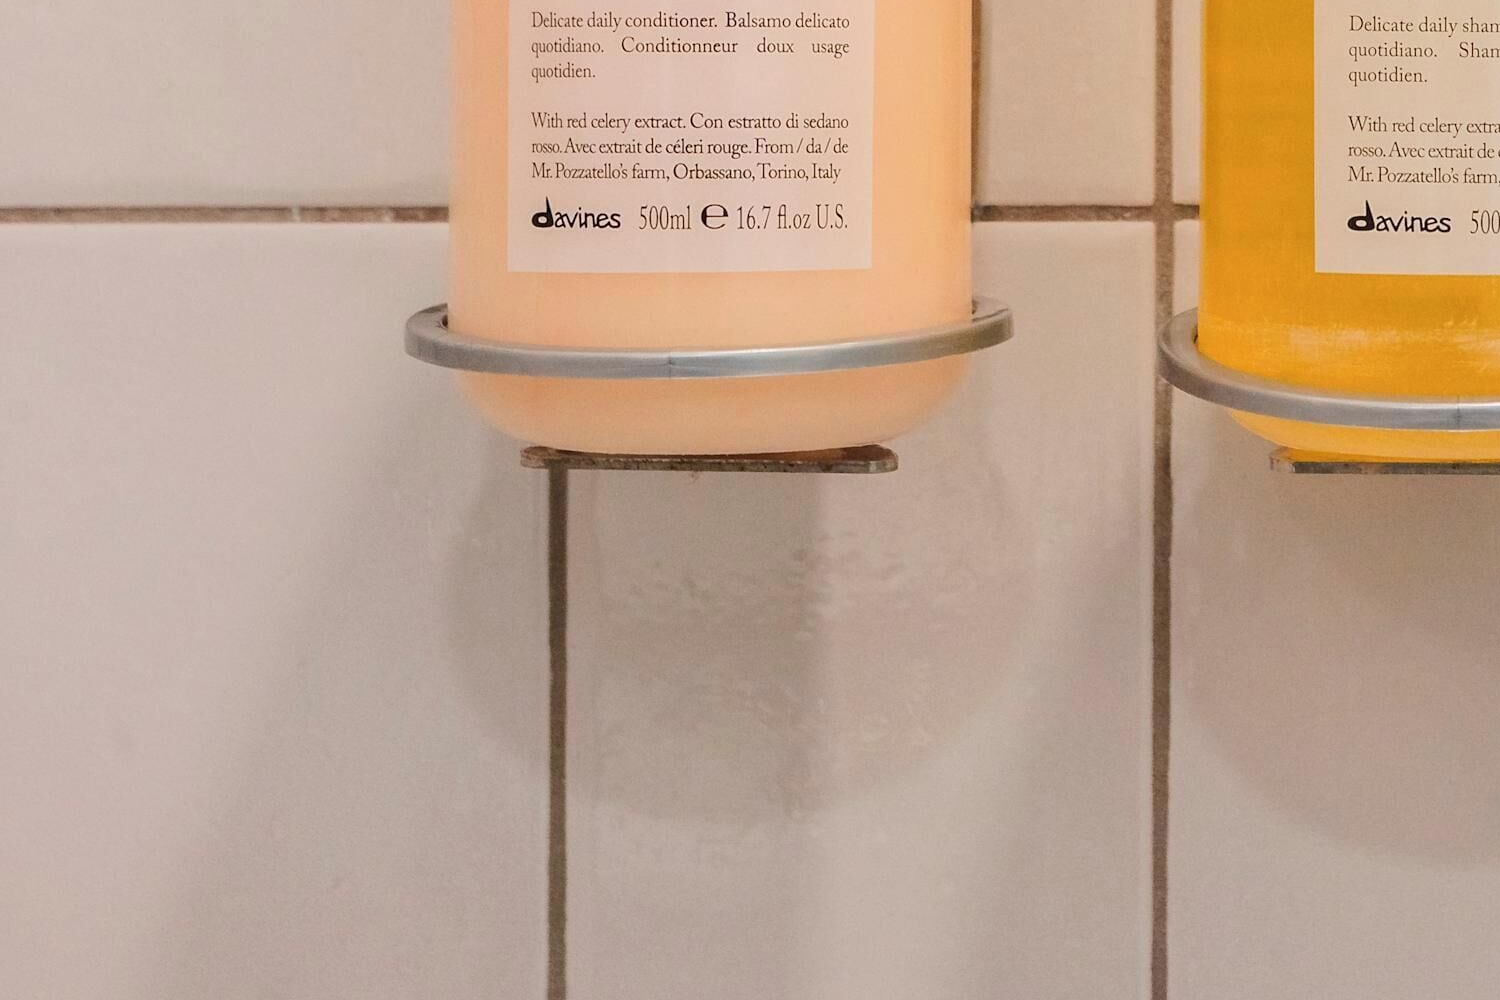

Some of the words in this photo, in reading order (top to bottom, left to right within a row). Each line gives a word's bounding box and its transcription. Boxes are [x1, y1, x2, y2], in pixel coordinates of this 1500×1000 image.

[532, 12, 583, 27] Delicate
[587, 11, 622, 32] daily
[625, 11, 717, 27] conditioner.
[725, 12, 791, 28] Balsamo
[795, 12, 849, 28] delicato
[1350, 15, 1413, 32] Delicate
[1419, 16, 1458, 38] daily
[531, 37, 604, 58] quotidiano.
[622, 36, 738, 53] Conditionneur
[757, 37, 794, 53] doux
[812, 43, 849, 59] usage
[1349, 41, 1437, 62] quotidiano.
[532, 62, 595, 83] quotidien.
[1349, 66, 1427, 87] quotidien.
[531, 112, 563, 128] With
[567, 112, 587, 128] red
[591, 112, 631, 134] celery
[635, 117, 686, 128] extract.
[690, 113, 723, 128] Con
[728, 117, 781, 128] estratto
[786, 113, 799, 128] di
[803, 113, 848, 128] sedano
[1348, 116, 1387, 132] With
[1392, 117, 1415, 132] red
[1420, 117, 1463, 138] celery
[532, 143, 562, 153] rosso.
[564, 137, 596, 153] Avec
[599, 139, 642, 153] extrait
[645, 138, 662, 153] de
[666, 138, 703, 153] céleri
[707, 144, 751, 159] rouge.
[1349, 147, 1386, 157] rosso.
[1389, 141, 1425, 158] Avec
[1428, 144, 1474, 158] extrait
[1477, 142, 1494, 158] de
[532, 162, 552, 178] Mr.
[632, 163, 670, 182] farm,
[673, 163, 755, 182] Orbassano,
[757, 162, 808, 181] Torino,
[812, 163, 841, 184] Italy
[1348, 166, 1374, 182] Mr.
[532, 196, 621, 228] davines
[639, 205, 691, 230] 500ml
[737, 206, 771, 229] 16.7
[816, 204, 847, 229] U.S.
[1347, 200, 1451, 233] davines
